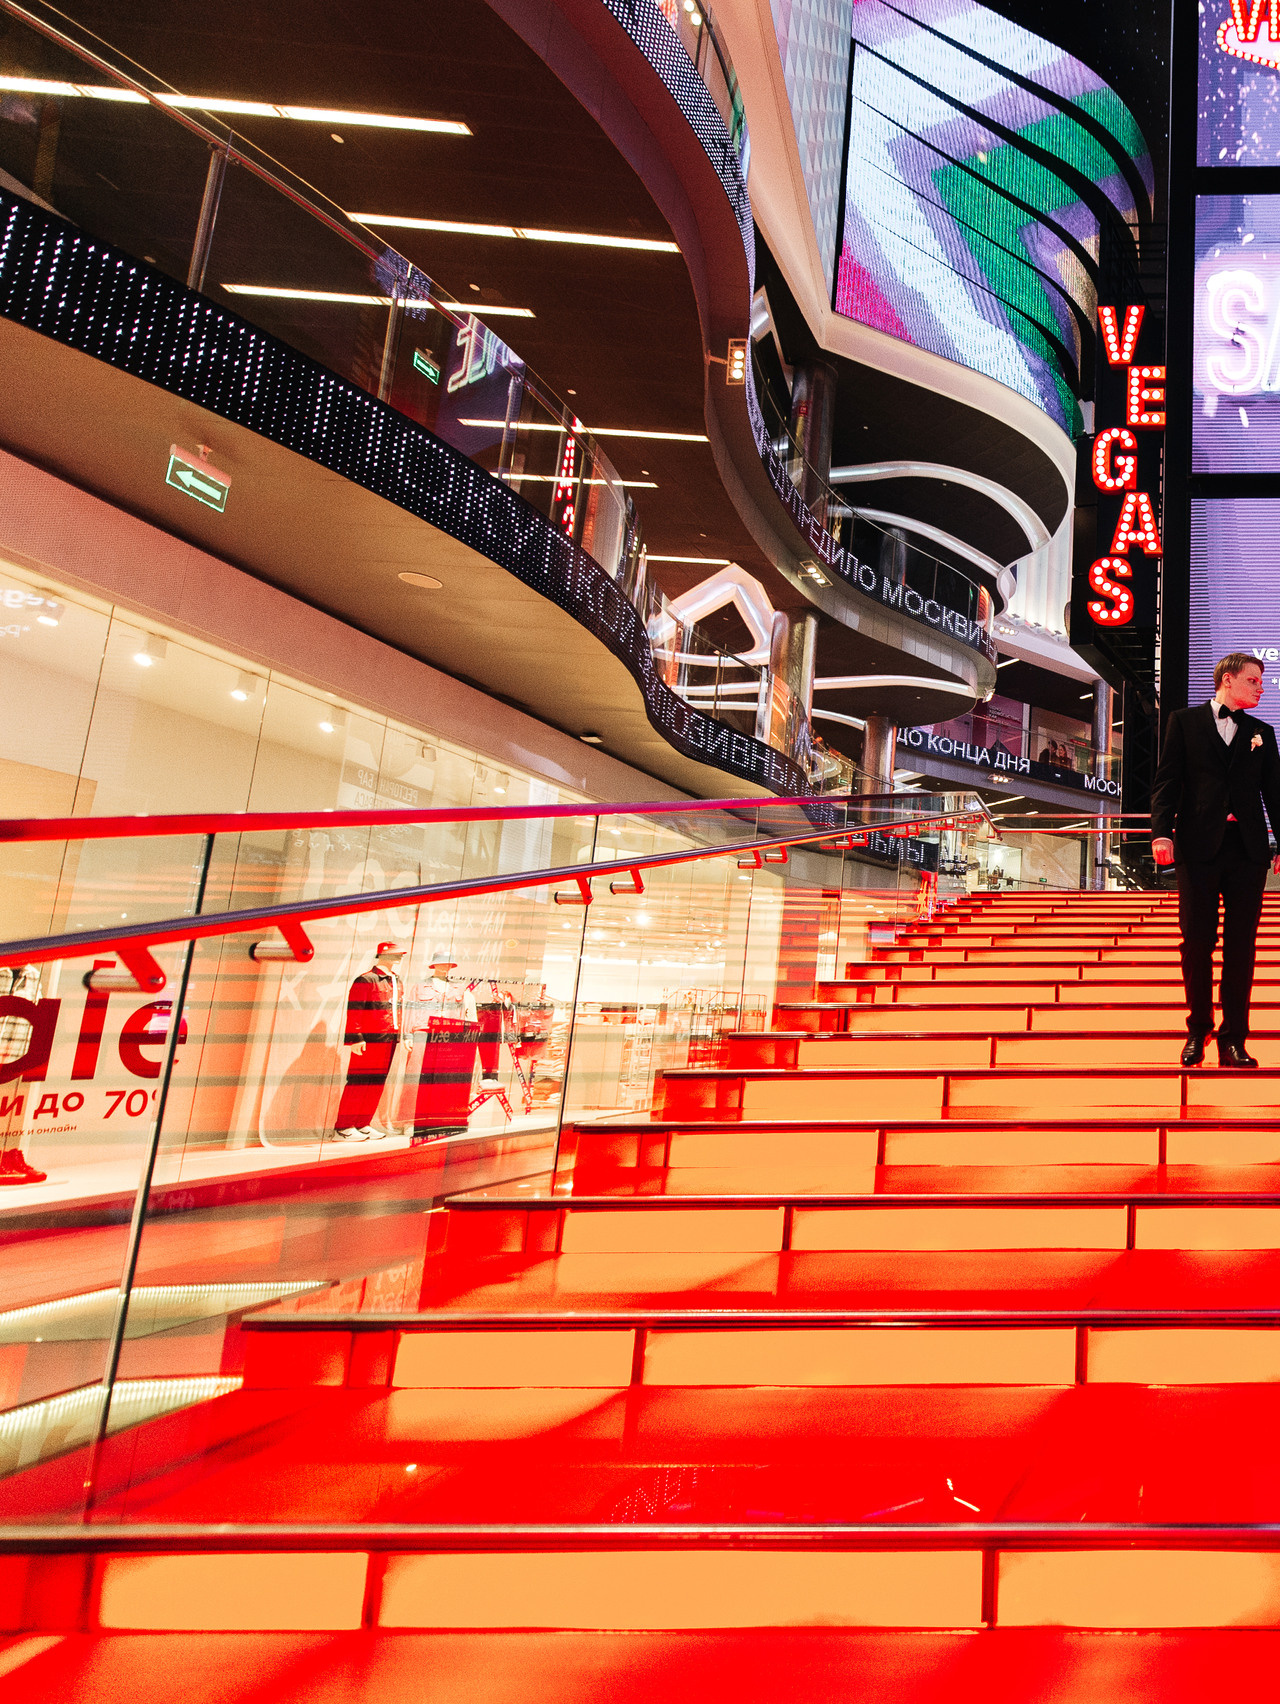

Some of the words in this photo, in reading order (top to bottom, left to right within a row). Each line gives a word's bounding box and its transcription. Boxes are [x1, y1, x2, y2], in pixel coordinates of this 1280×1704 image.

[1086, 304, 1167, 627] VEGAS
[896, 727, 923, 747] ДО
[928, 735, 991, 765] КОНЦА
[994, 752, 1031, 774] ДНЯ
[33, 1091, 85, 1120] до
[103, 1088, 158, 1120] 70
[36, 1124, 77, 1136] онлайн
